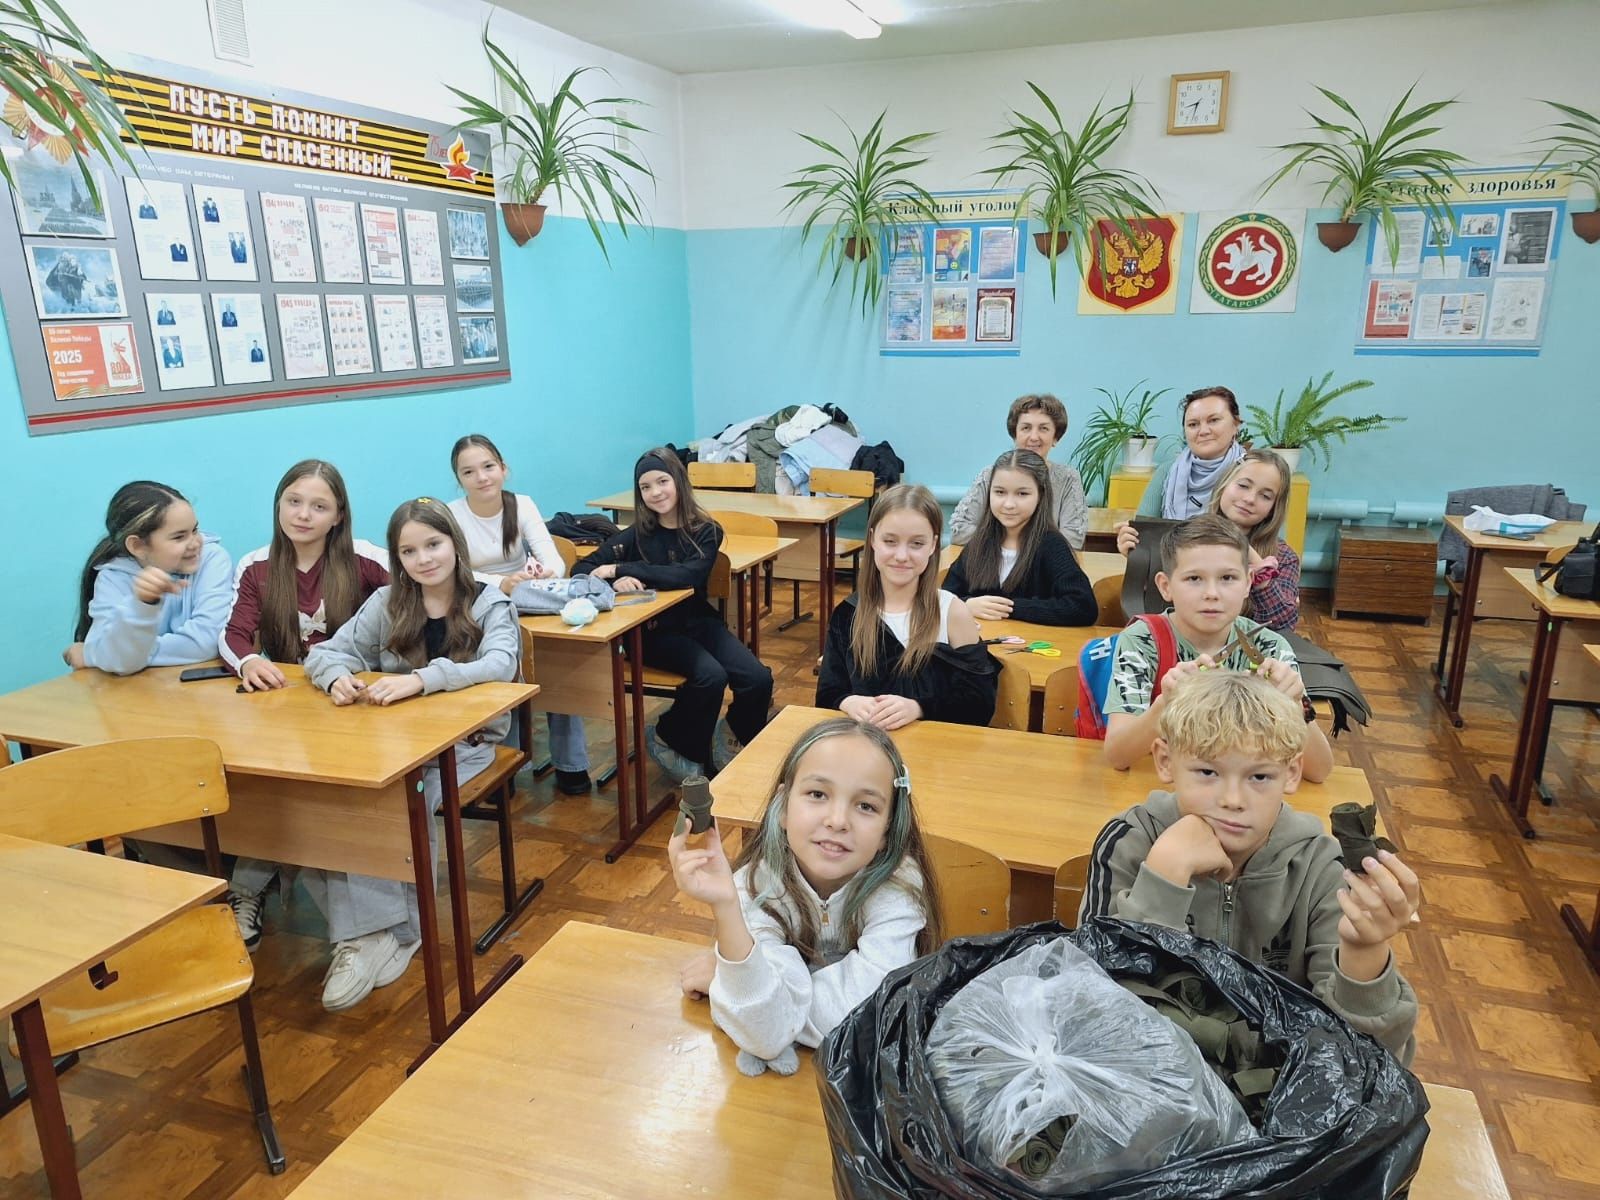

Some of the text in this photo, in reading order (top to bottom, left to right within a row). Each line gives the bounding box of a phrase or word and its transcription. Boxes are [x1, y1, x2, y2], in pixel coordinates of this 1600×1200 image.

[169, 83, 361, 144] ПУСТЬ ПОМНИТ
[191, 122, 409, 182] МИР СПАСЕННЫЙ...
[1468, 178, 1557, 196] здоровья
[888, 200, 963, 215] Класный
[53, 349, 83, 365] 2025
